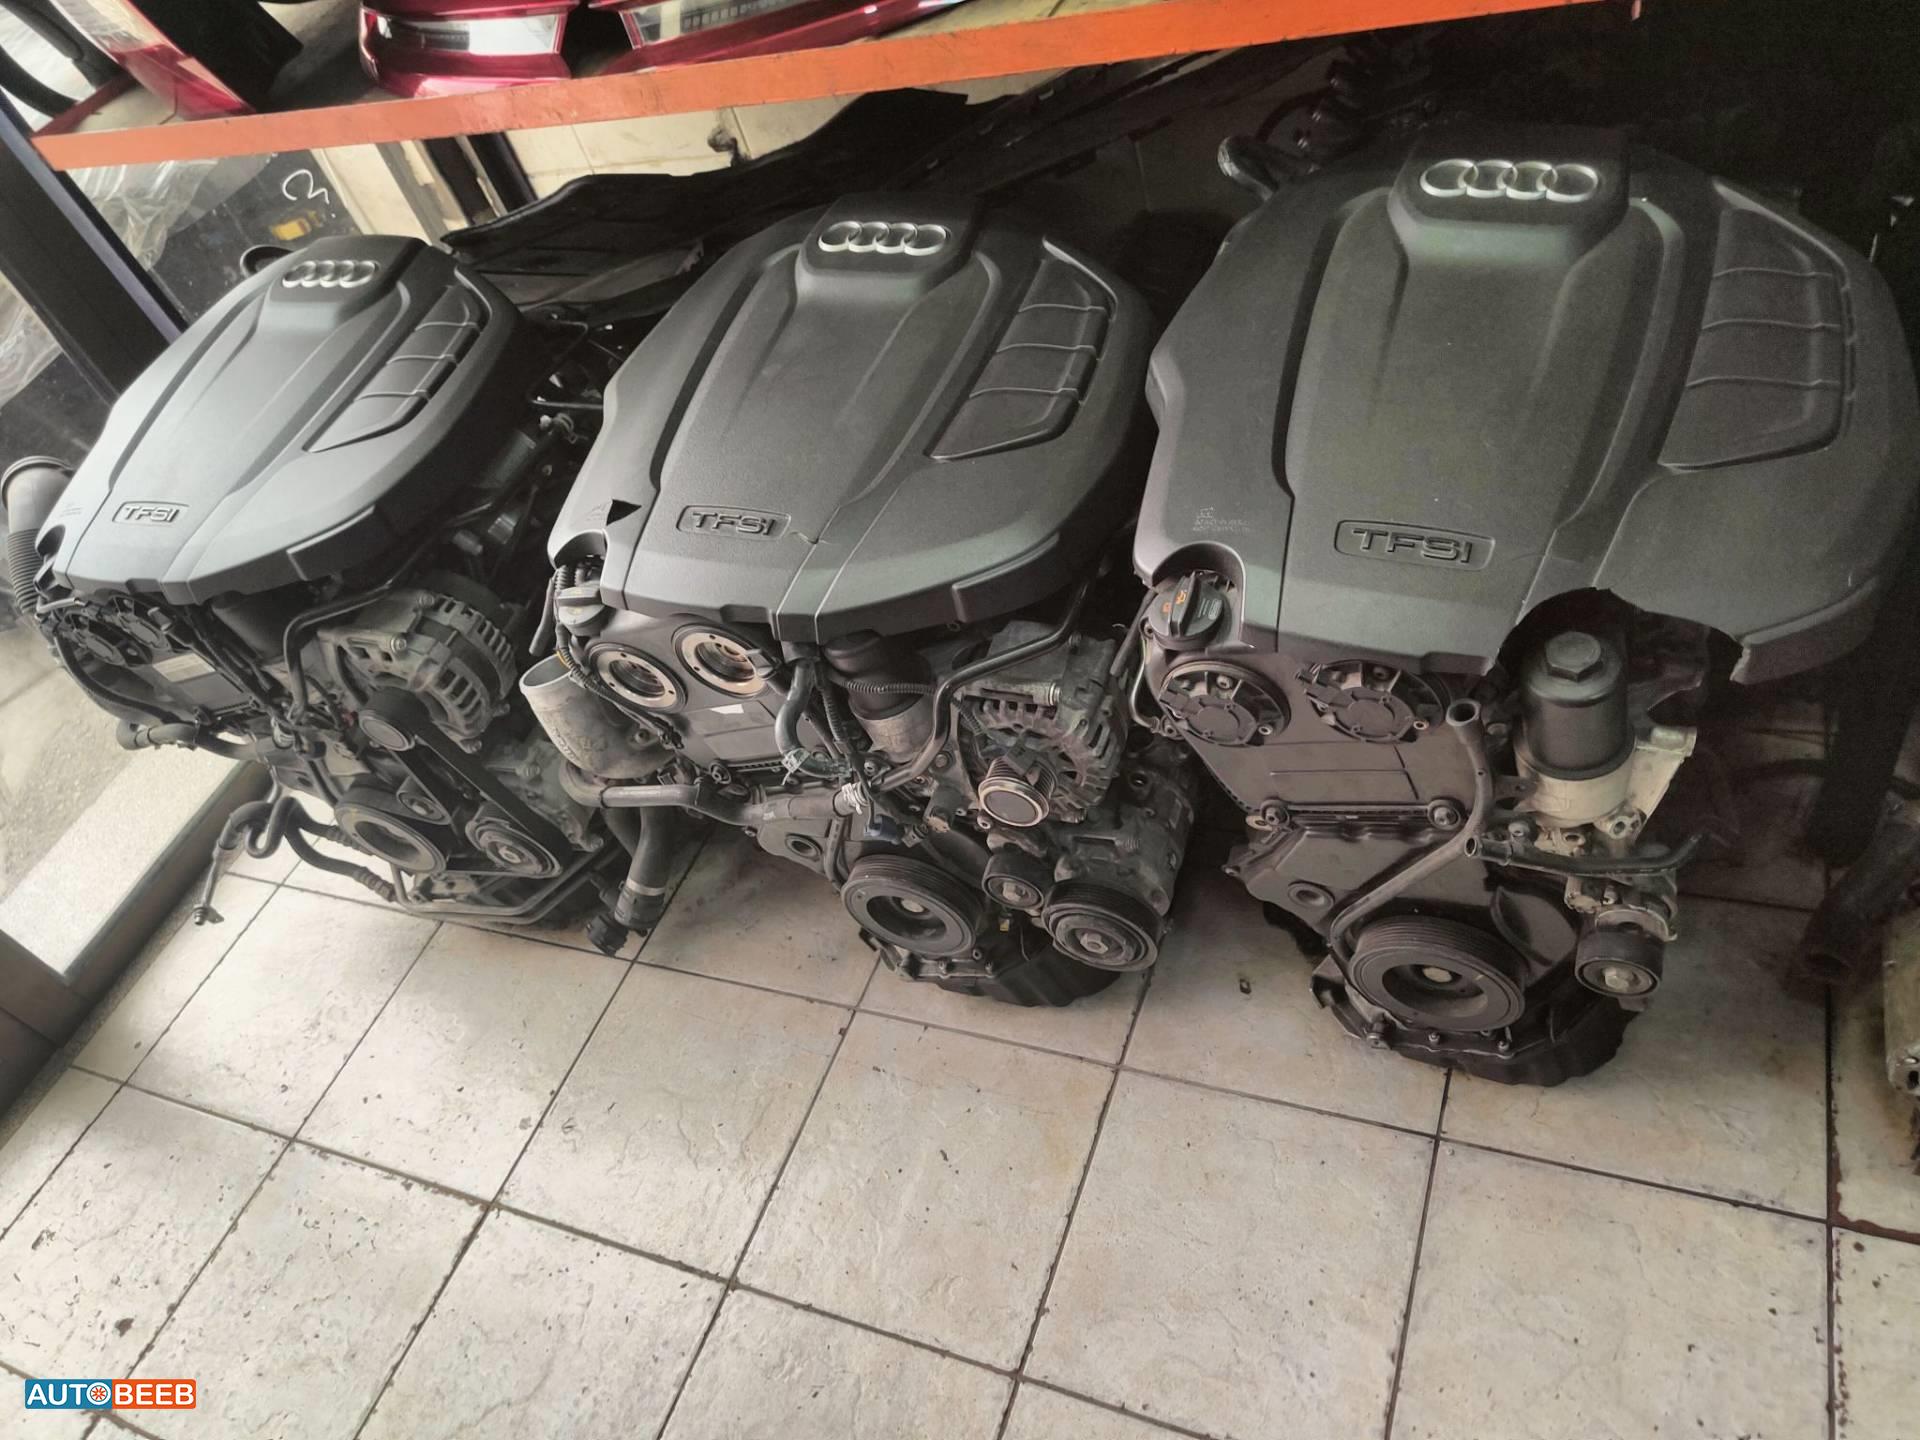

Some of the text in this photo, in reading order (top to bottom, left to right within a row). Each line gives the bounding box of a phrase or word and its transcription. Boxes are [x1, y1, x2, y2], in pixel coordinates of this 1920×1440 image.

[125, 507, 180, 523] TFSI
[692, 512, 776, 536] TFSI
[1352, 527, 1473, 564] TFSI
